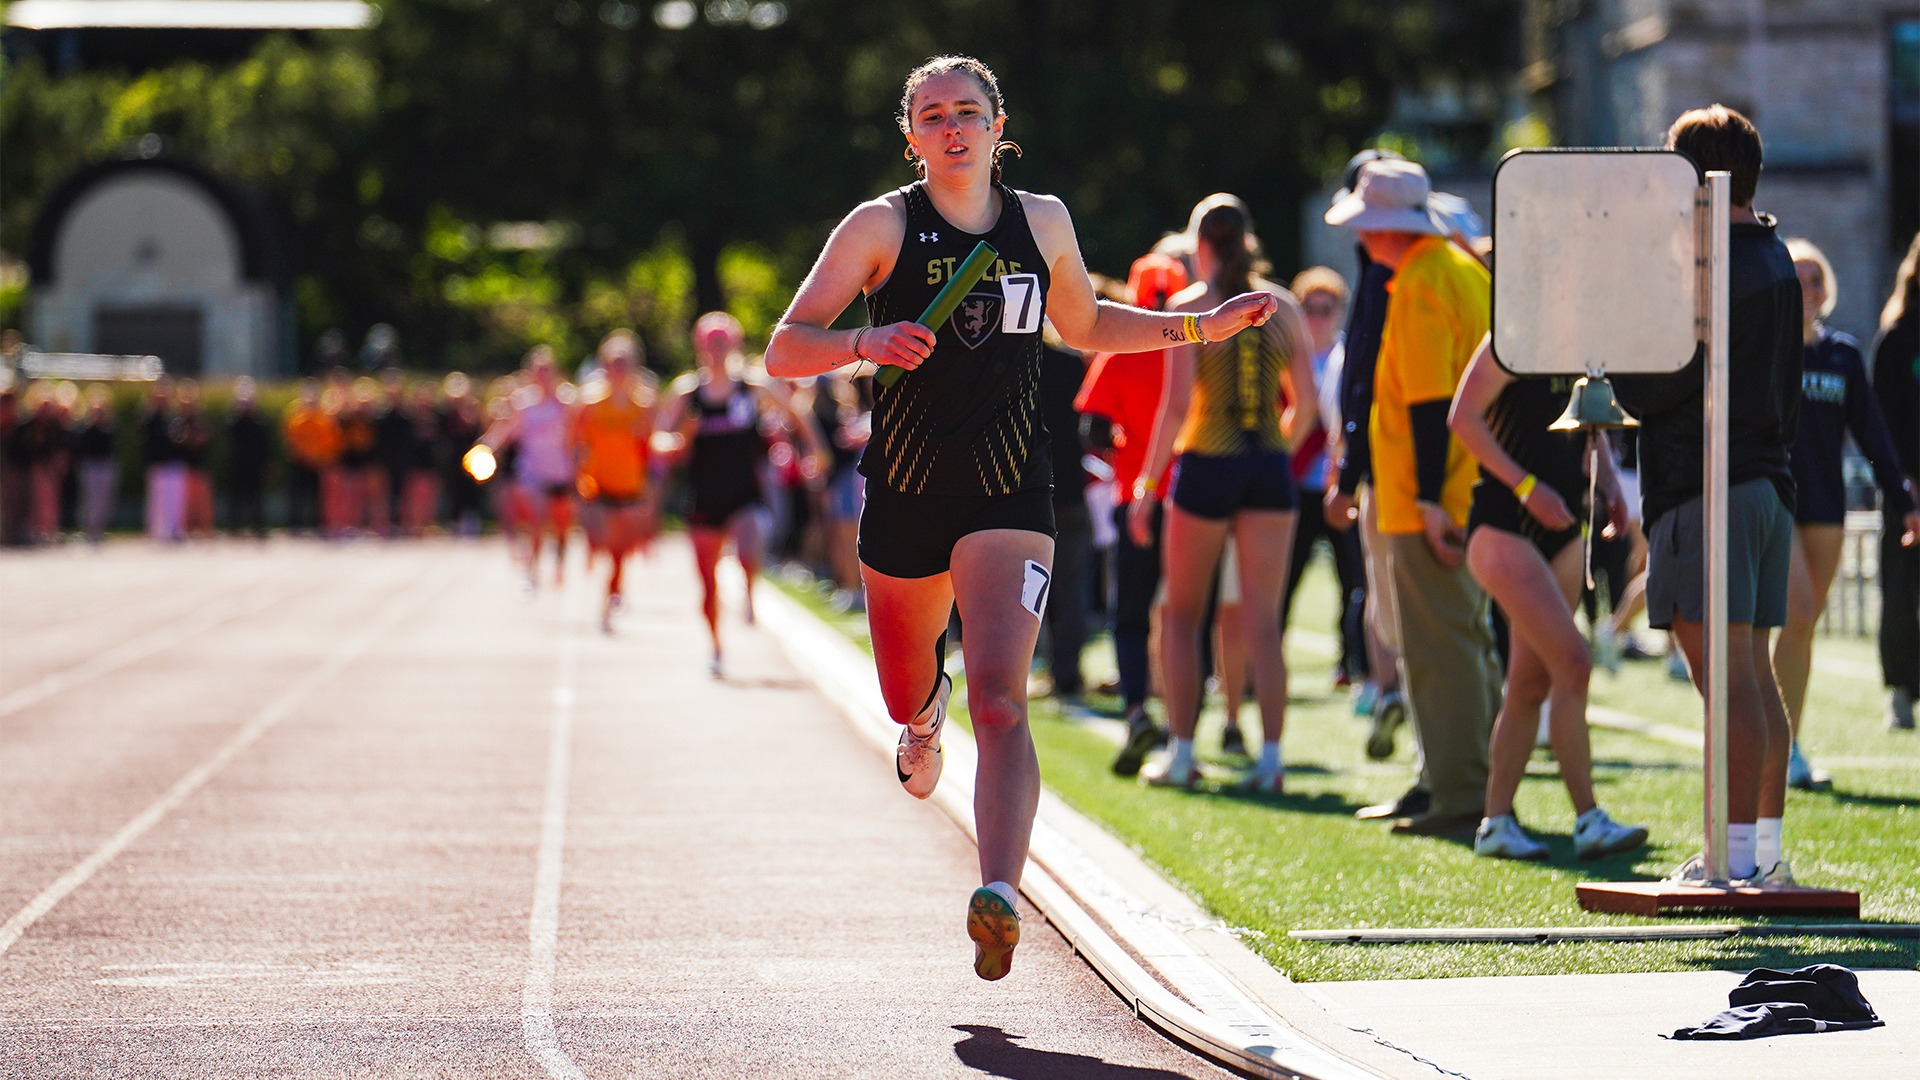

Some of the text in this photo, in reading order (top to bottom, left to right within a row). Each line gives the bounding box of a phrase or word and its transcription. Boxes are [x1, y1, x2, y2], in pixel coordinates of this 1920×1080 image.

[974, 259, 1022, 282] LAF
[1007, 277, 1034, 329] 7
[1163, 328, 1186, 342] FSU
[1031, 563, 1050, 615] 7
